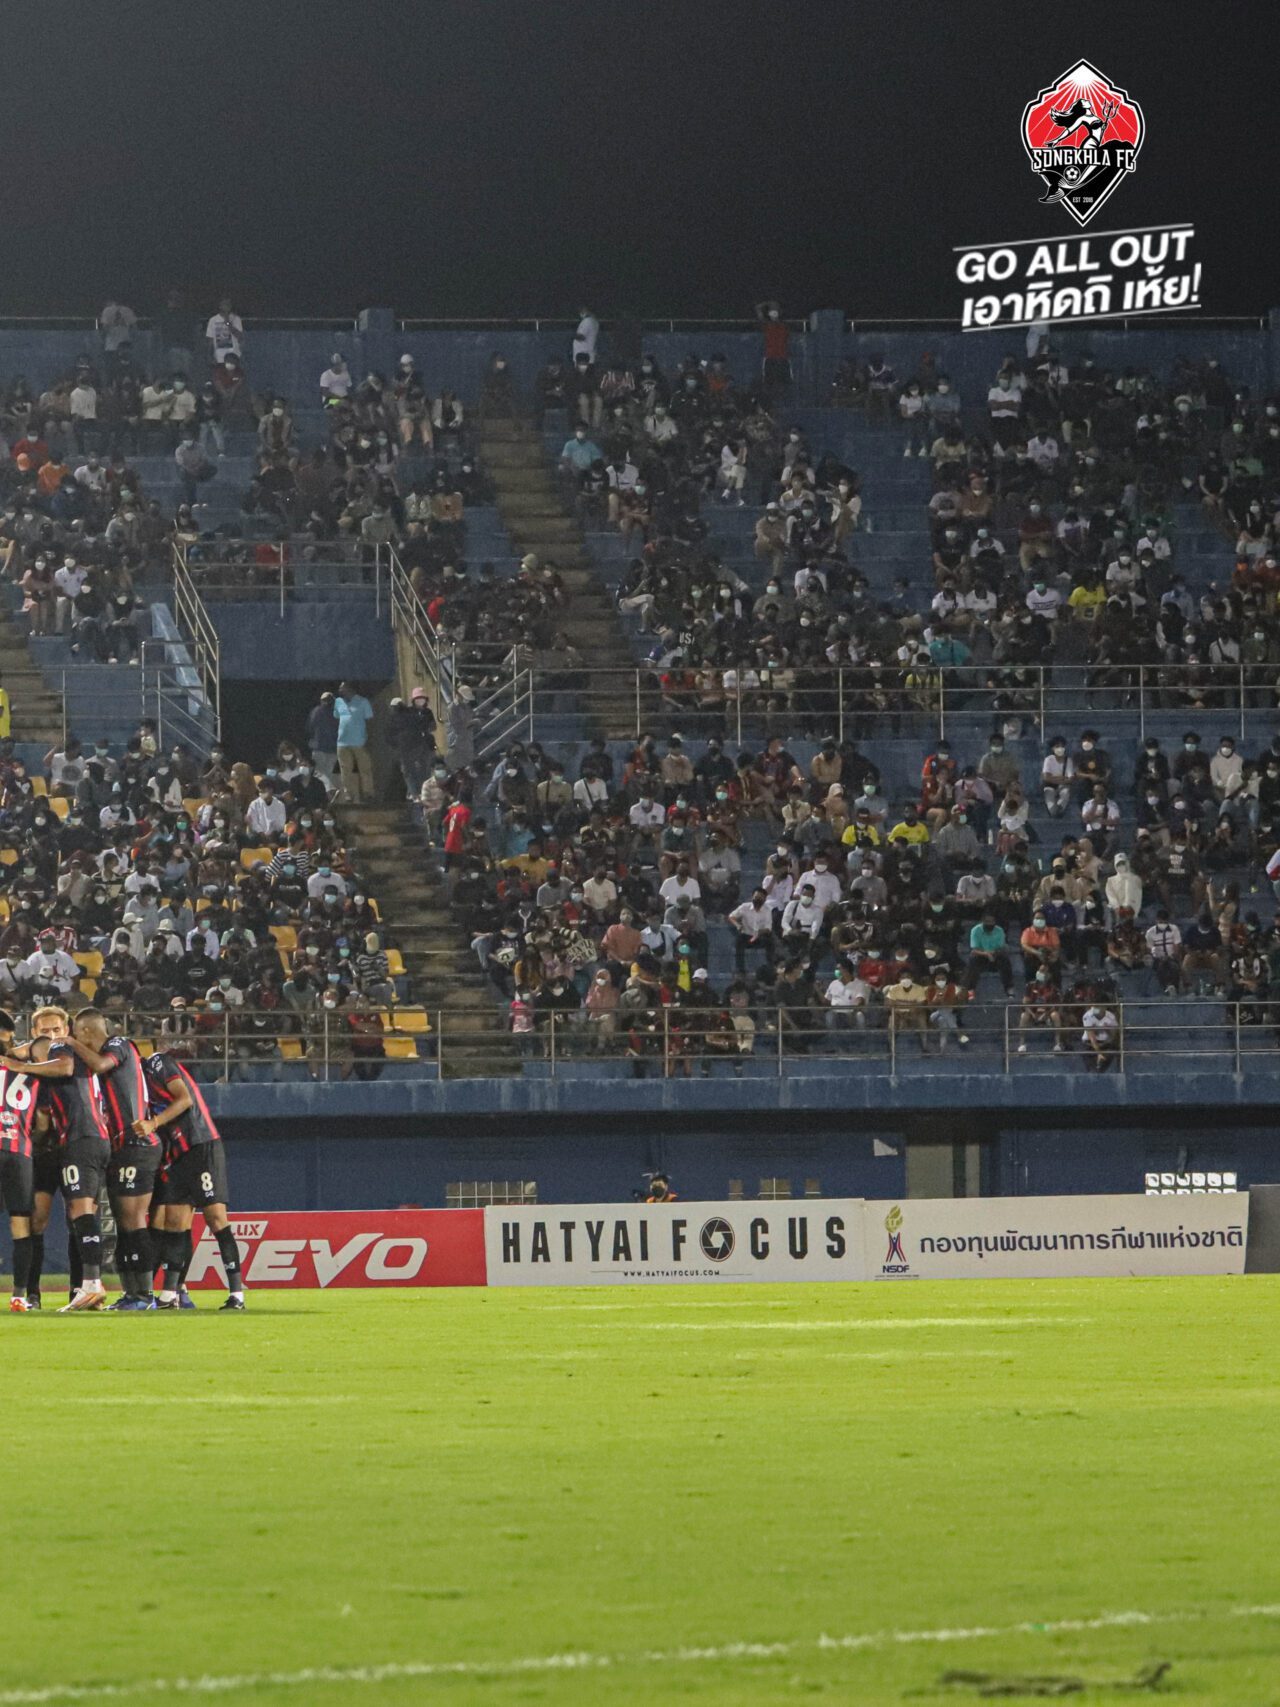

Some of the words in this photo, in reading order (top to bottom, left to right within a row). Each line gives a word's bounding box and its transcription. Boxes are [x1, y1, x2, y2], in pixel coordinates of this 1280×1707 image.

[62, 1164, 80, 1187] 10
[119, 1166, 137, 1183] 19
[200, 1171, 214, 1192] 8
[501, 1219, 649, 1263] HATYAI
[919, 1225, 1244, 1259] กองทุนพัฒนาการกีฬาแห่งชาติ
[184, 1232, 428, 1289] REVO
[882, 1264, 910, 1273] NSDF
